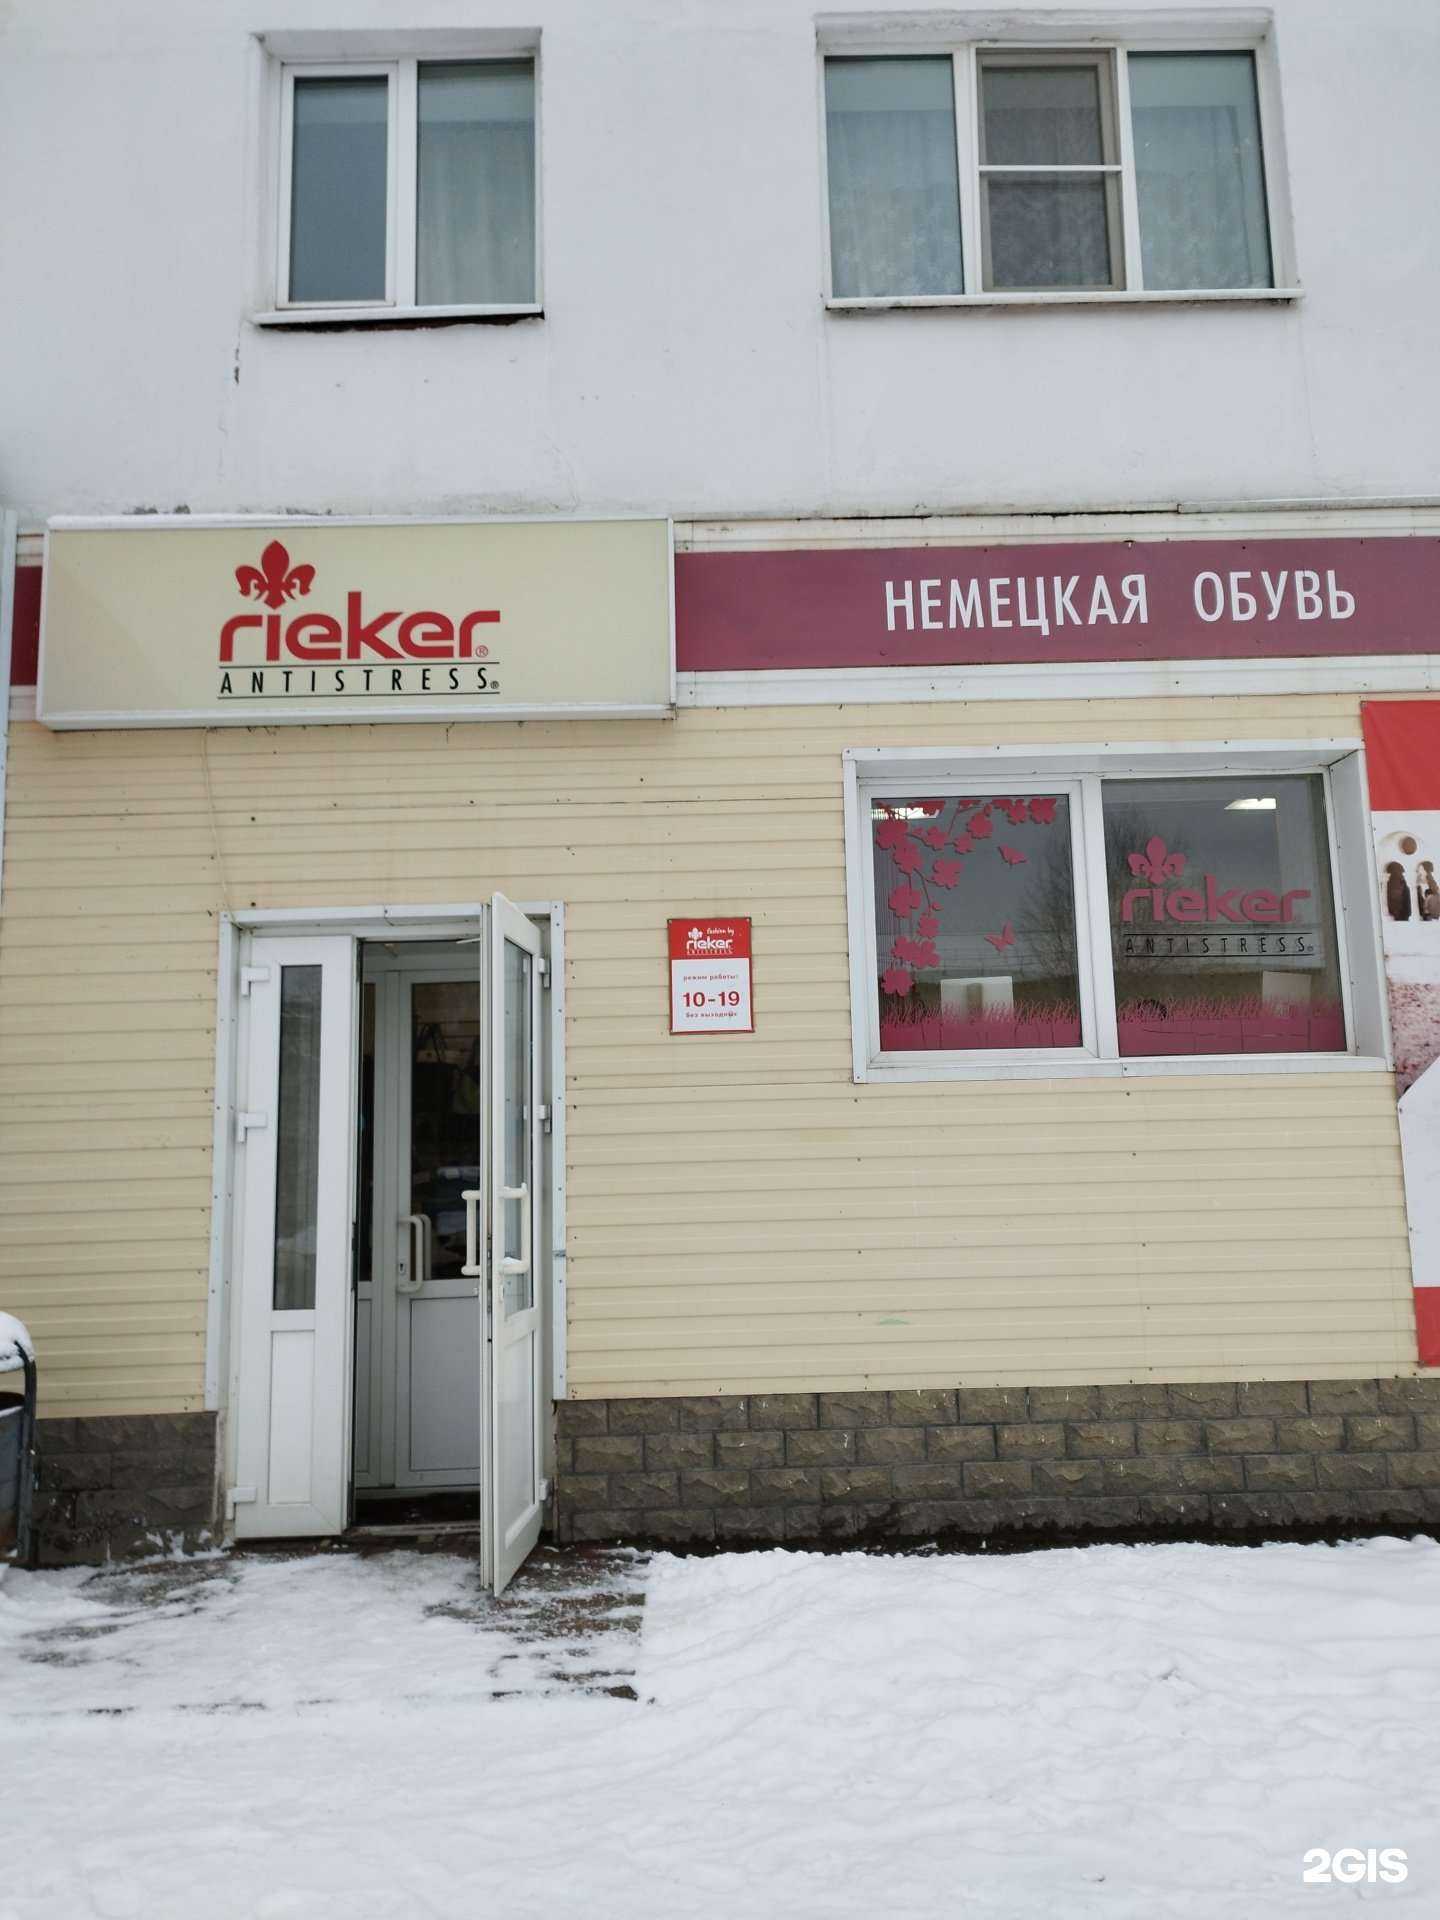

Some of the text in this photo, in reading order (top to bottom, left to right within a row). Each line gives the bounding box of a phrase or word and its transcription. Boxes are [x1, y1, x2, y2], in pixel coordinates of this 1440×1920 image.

[885, 570, 1356, 635] НЕМЕЦКАЯ ОБУВЬ
[220, 591, 501, 661] rieker
[220, 668, 499, 694] ANTISTRESS
[1122, 874, 1312, 924] rieker
[686, 936, 733, 949] rieker
[1125, 936, 1314, 954] ANTISTRESS
[683, 991, 740, 1007] 10-19
